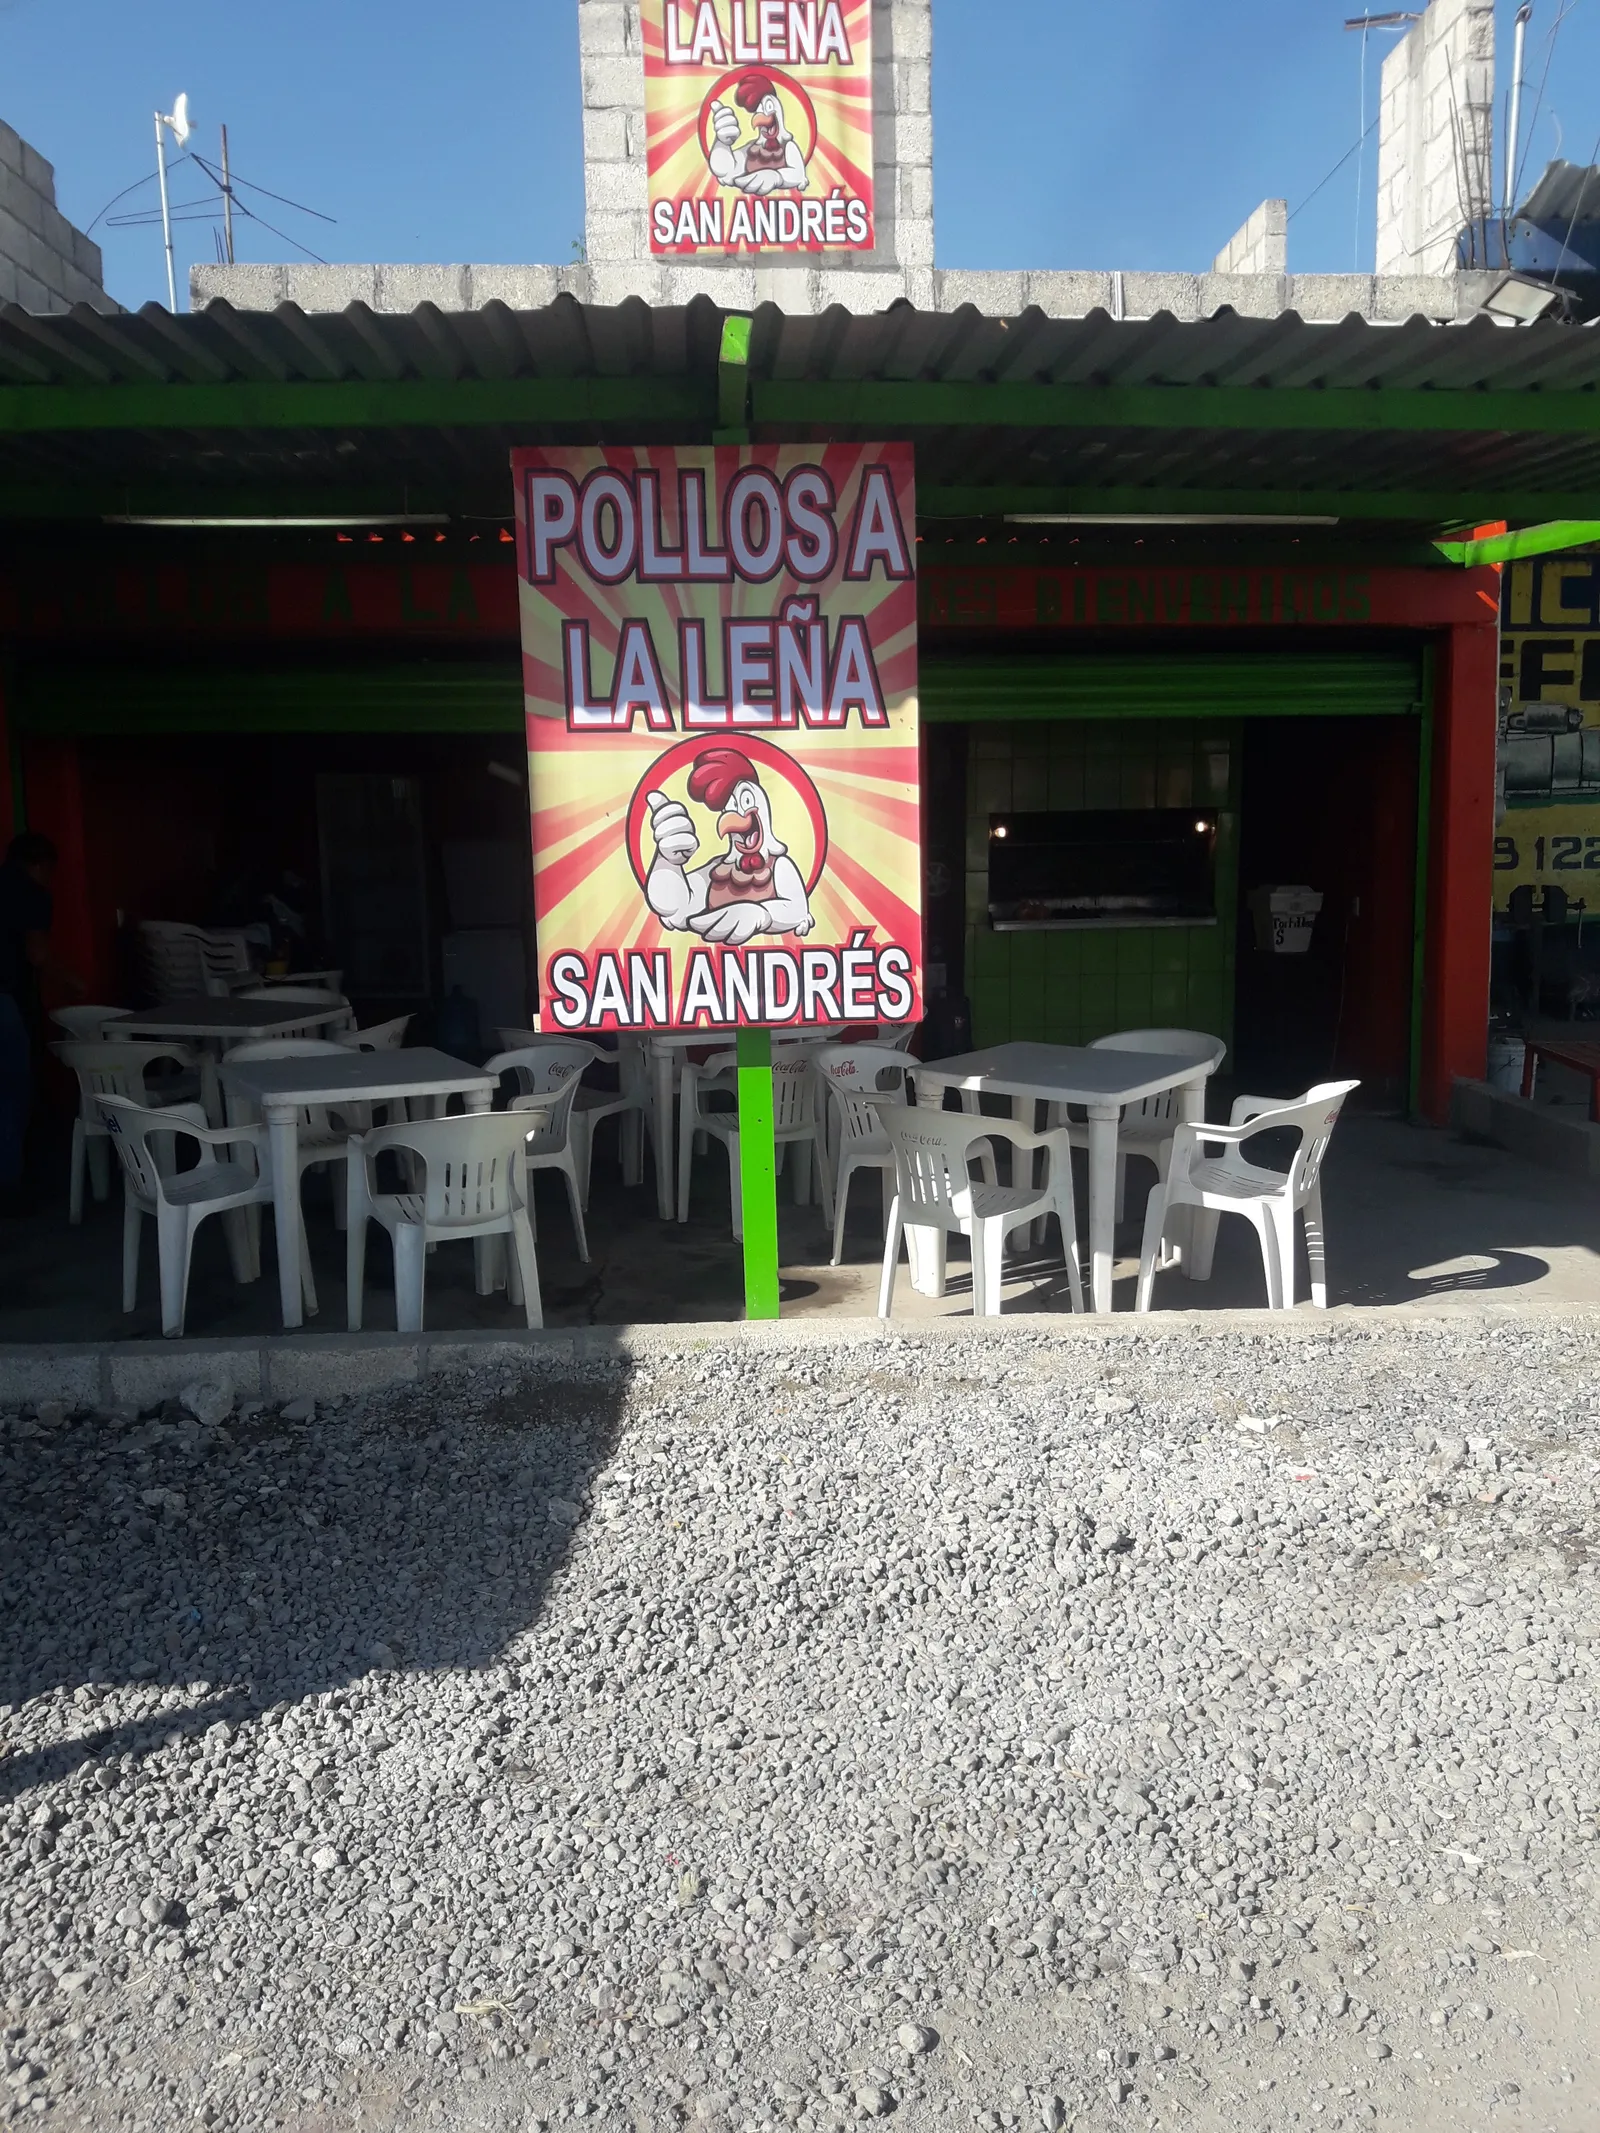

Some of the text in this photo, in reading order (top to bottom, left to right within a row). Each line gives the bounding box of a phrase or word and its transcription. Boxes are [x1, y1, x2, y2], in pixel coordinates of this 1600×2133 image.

[666, 0, 726, 63] LA
[652, 189, 868, 245] SAN ANDRÉS
[528, 467, 909, 580] POLLOS A
[1035, 571, 1371, 624] BIENVENIDOS
[565, 599, 885, 728] LA LEÑA
[551, 931, 914, 1025] SAN ANDRÉS
